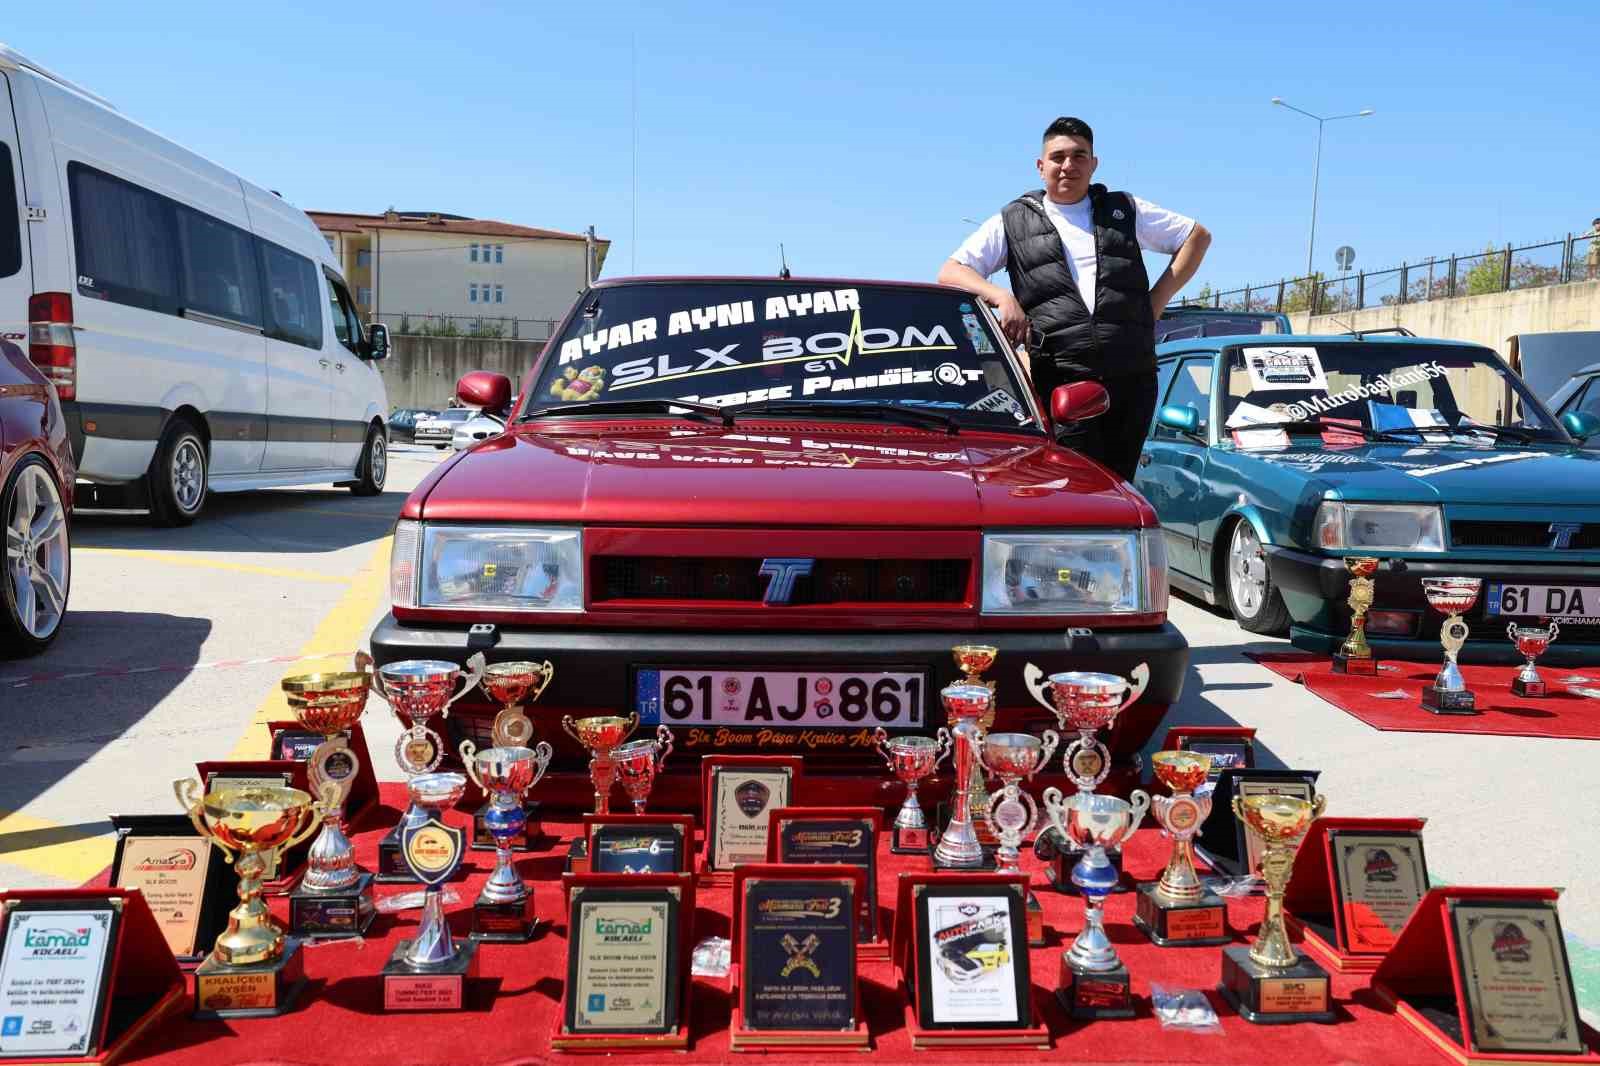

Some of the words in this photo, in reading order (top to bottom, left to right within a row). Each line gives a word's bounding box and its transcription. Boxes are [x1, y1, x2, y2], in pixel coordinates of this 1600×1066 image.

[559, 317, 656, 366] AYAR
[668, 301, 755, 336] AYNI
[765, 288, 860, 320] AYAR
[610, 343, 742, 387] SLX
[762, 325, 958, 362] BOOM
[803, 359, 837, 373] 61
[1501, 586, 1530, 613] 61
[1545, 588, 1585, 615] DA
[639, 701, 657, 714] TR
[663, 675, 713, 720] 61
[744, 676, 807, 721] AJ
[838, 677, 921, 723] 861
[714, 728, 752, 746] Boom
[825, 897, 842, 919] 3
[595, 917, 653, 934] kamad
[24, 927, 91, 947] kamad
